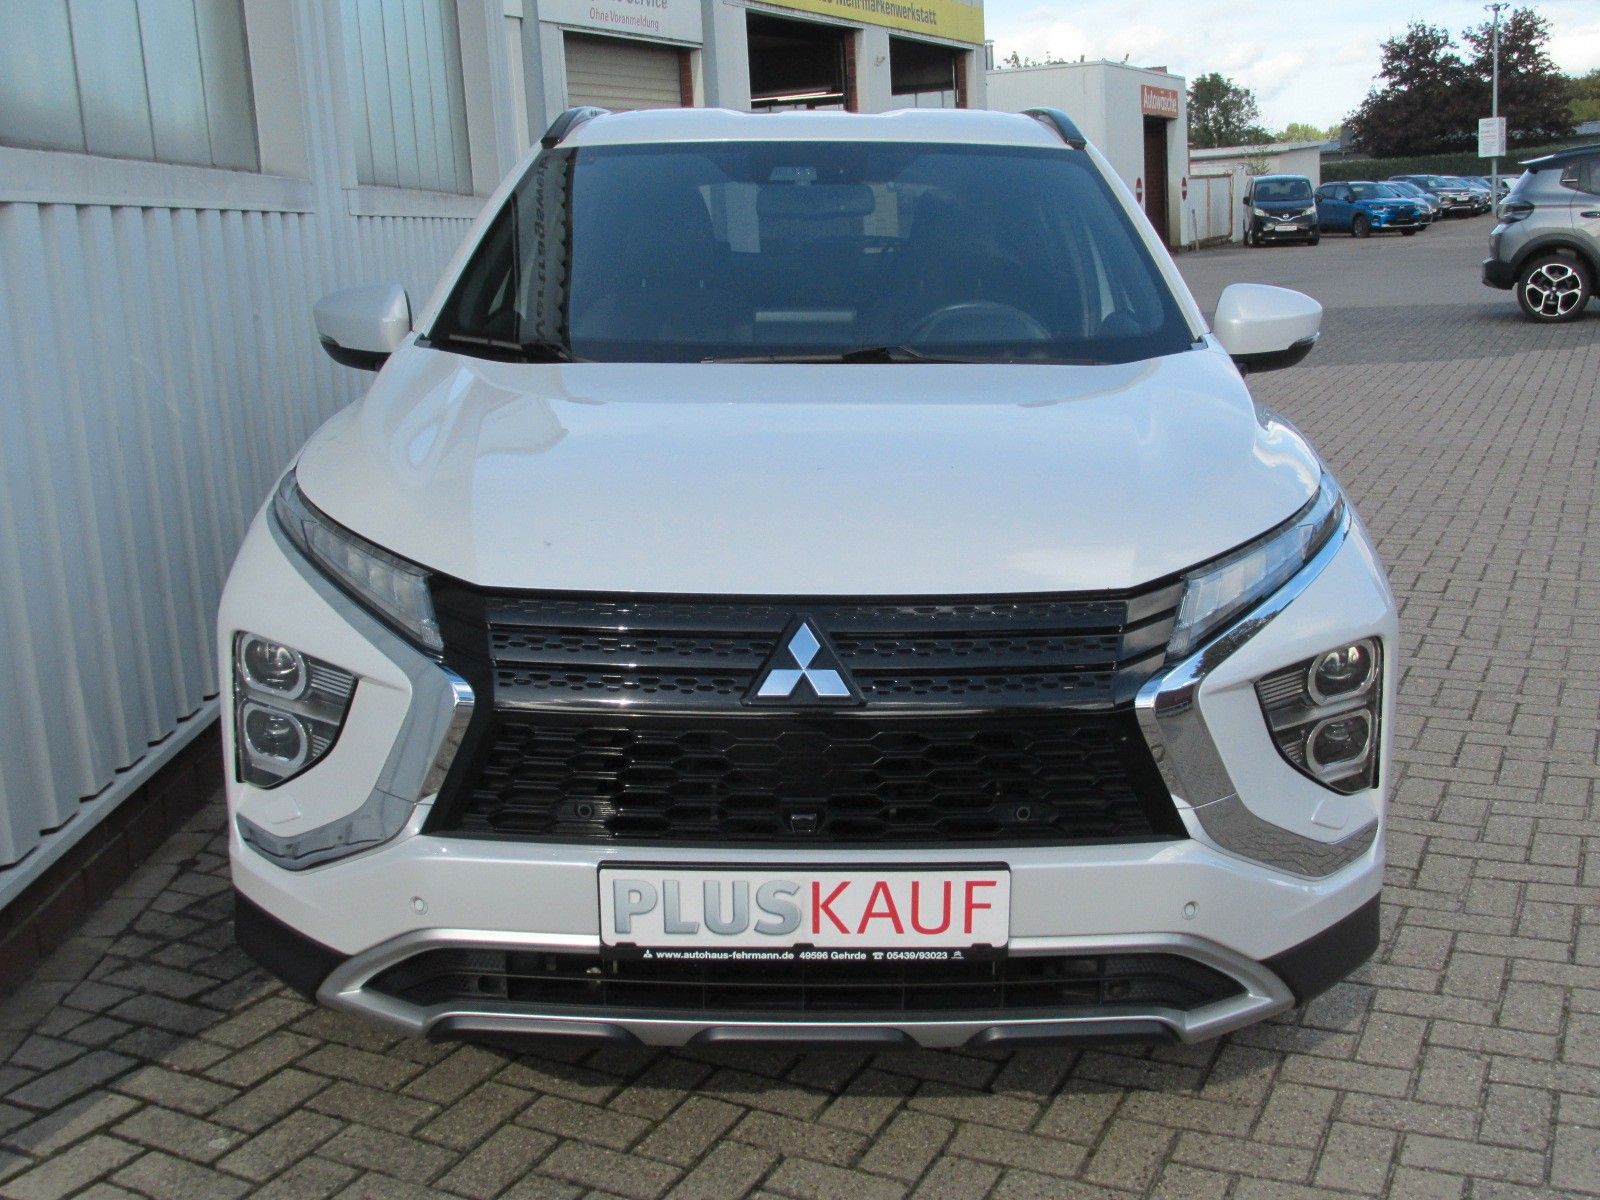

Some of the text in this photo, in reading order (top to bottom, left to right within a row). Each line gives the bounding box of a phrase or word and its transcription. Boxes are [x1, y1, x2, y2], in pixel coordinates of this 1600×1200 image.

[589, 7, 660, 31] Ohne Voranmeldung
[656, 950, 948, 961] www.autohaus-fehrmann.de 49596 Gehrde 05439/93023
